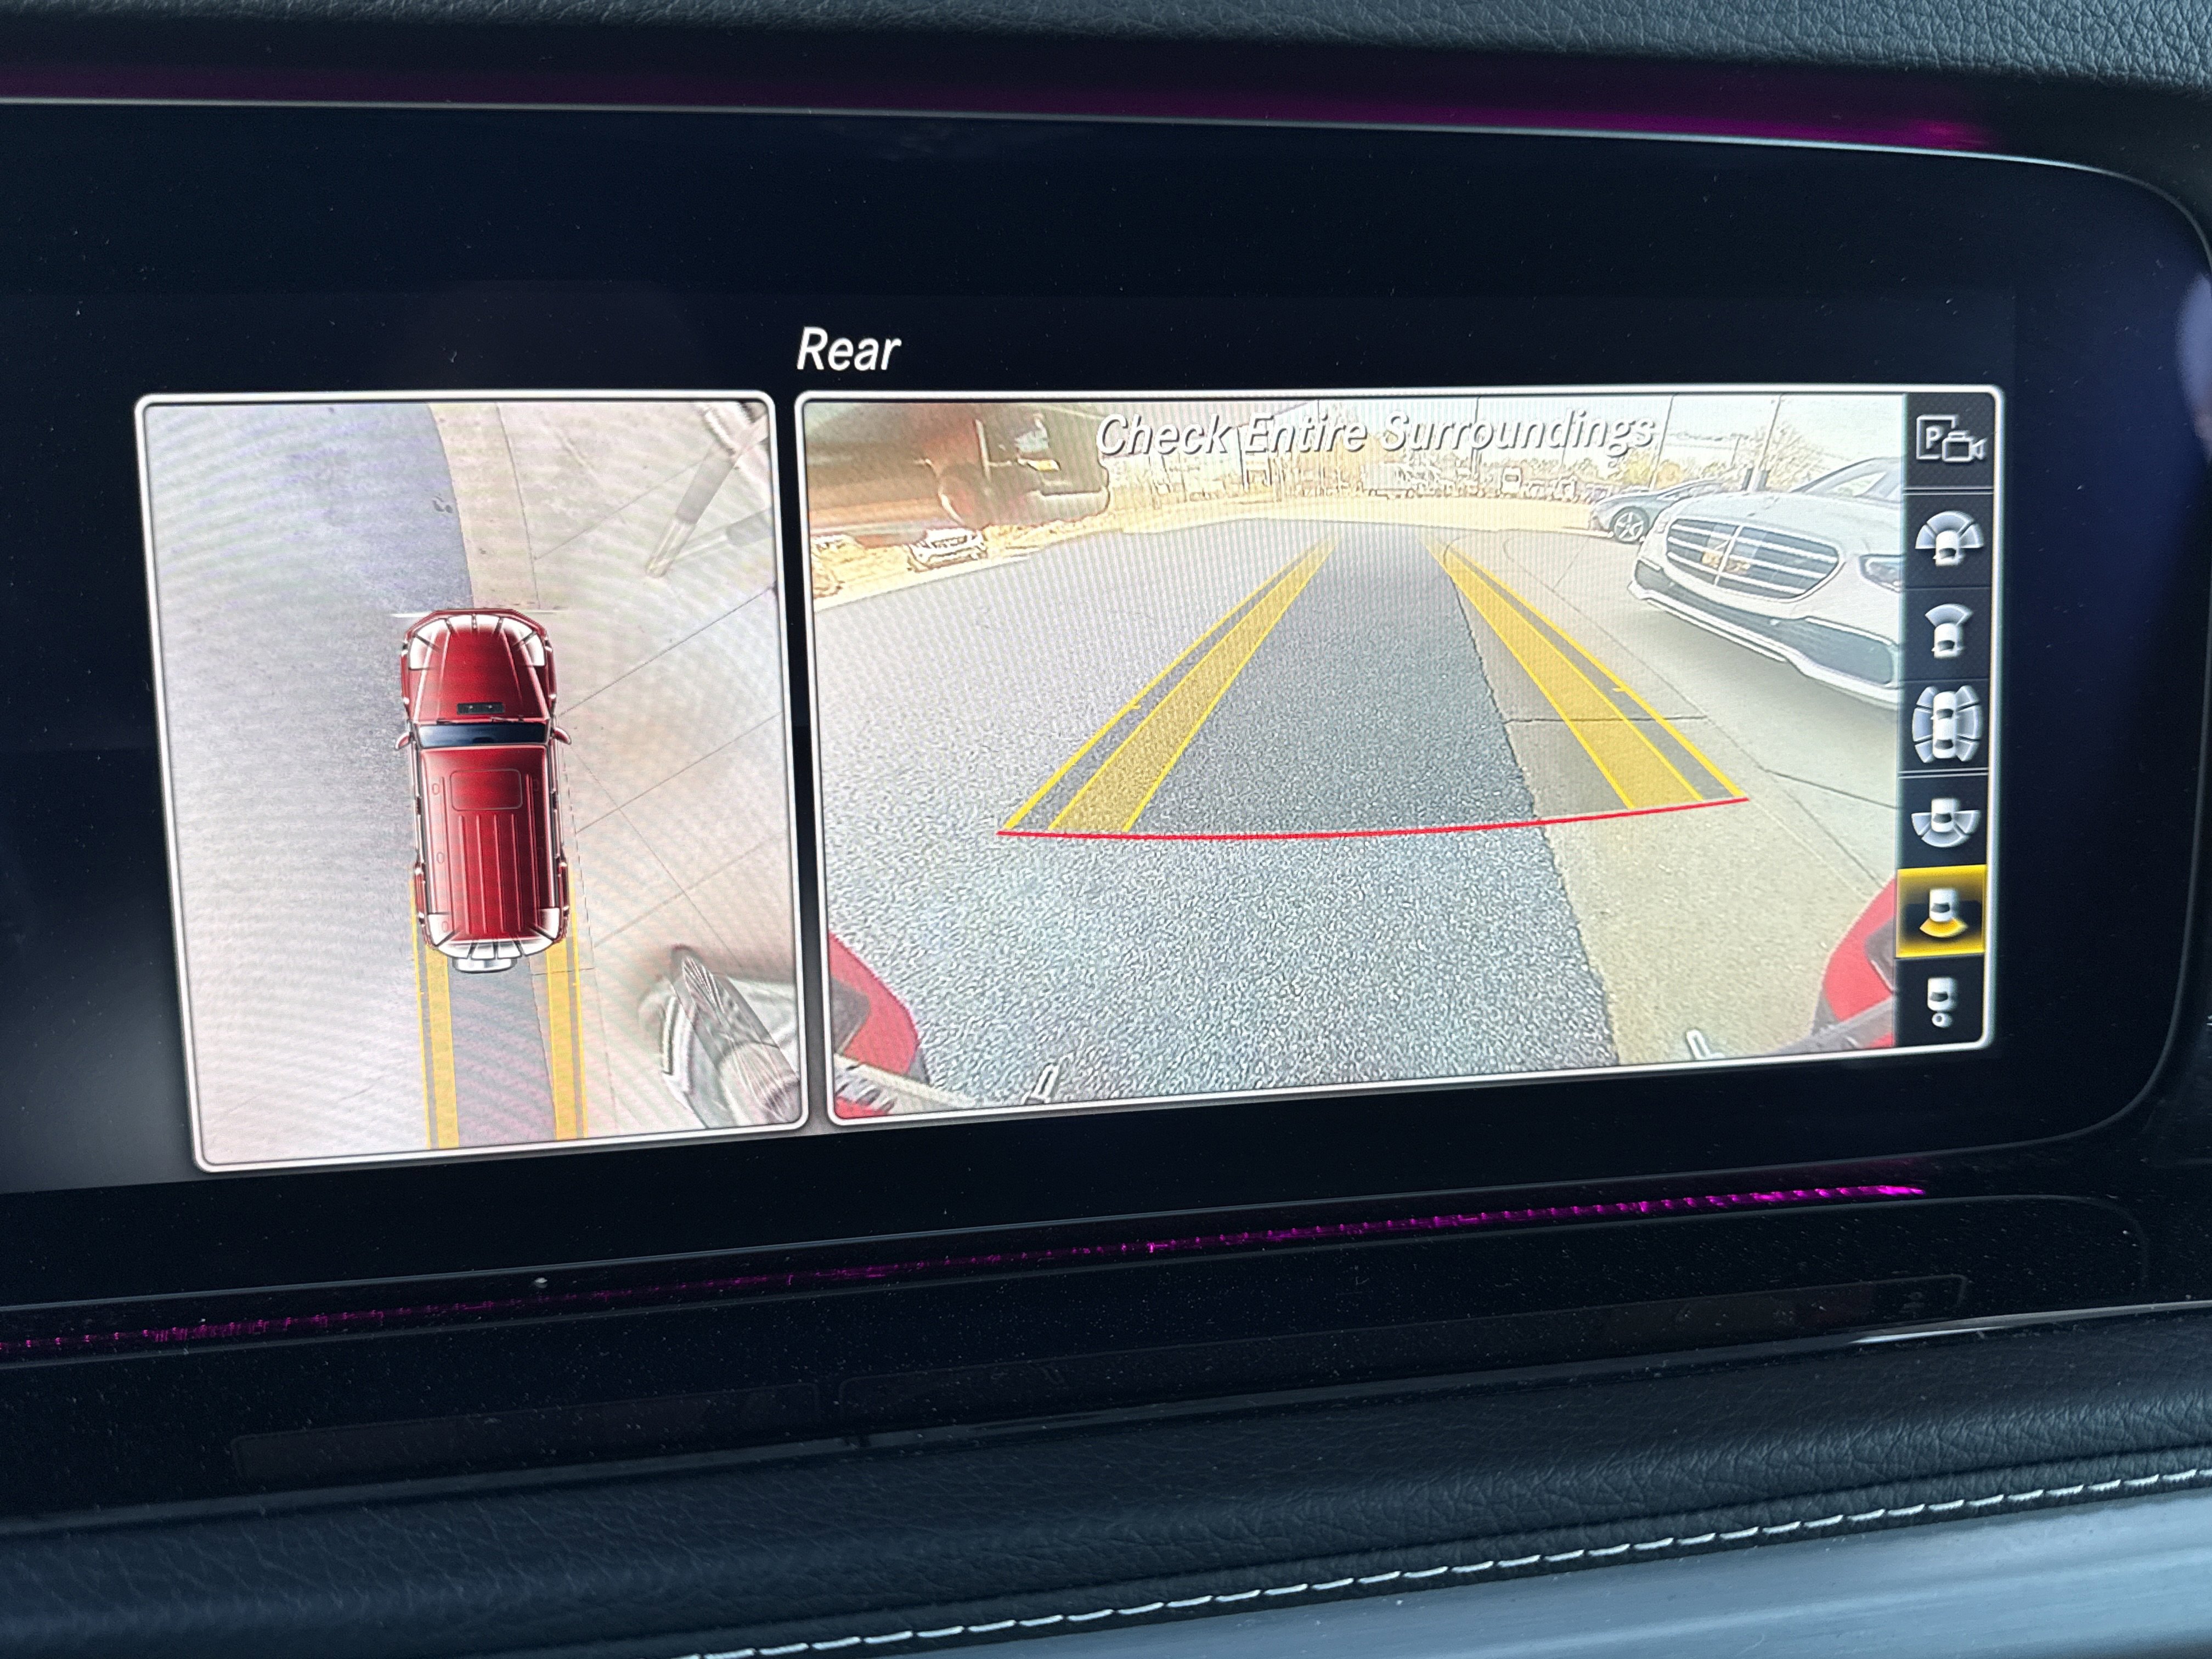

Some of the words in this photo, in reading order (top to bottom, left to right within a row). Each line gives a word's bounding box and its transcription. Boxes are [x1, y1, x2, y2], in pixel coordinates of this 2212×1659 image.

[797, 326, 902, 371] Rear
[1096, 413, 1231, 455] Check
[1245, 413, 1368, 453] Entire
[1383, 409, 1656, 457] Surroundings
[1926, 425, 1944, 449] P
